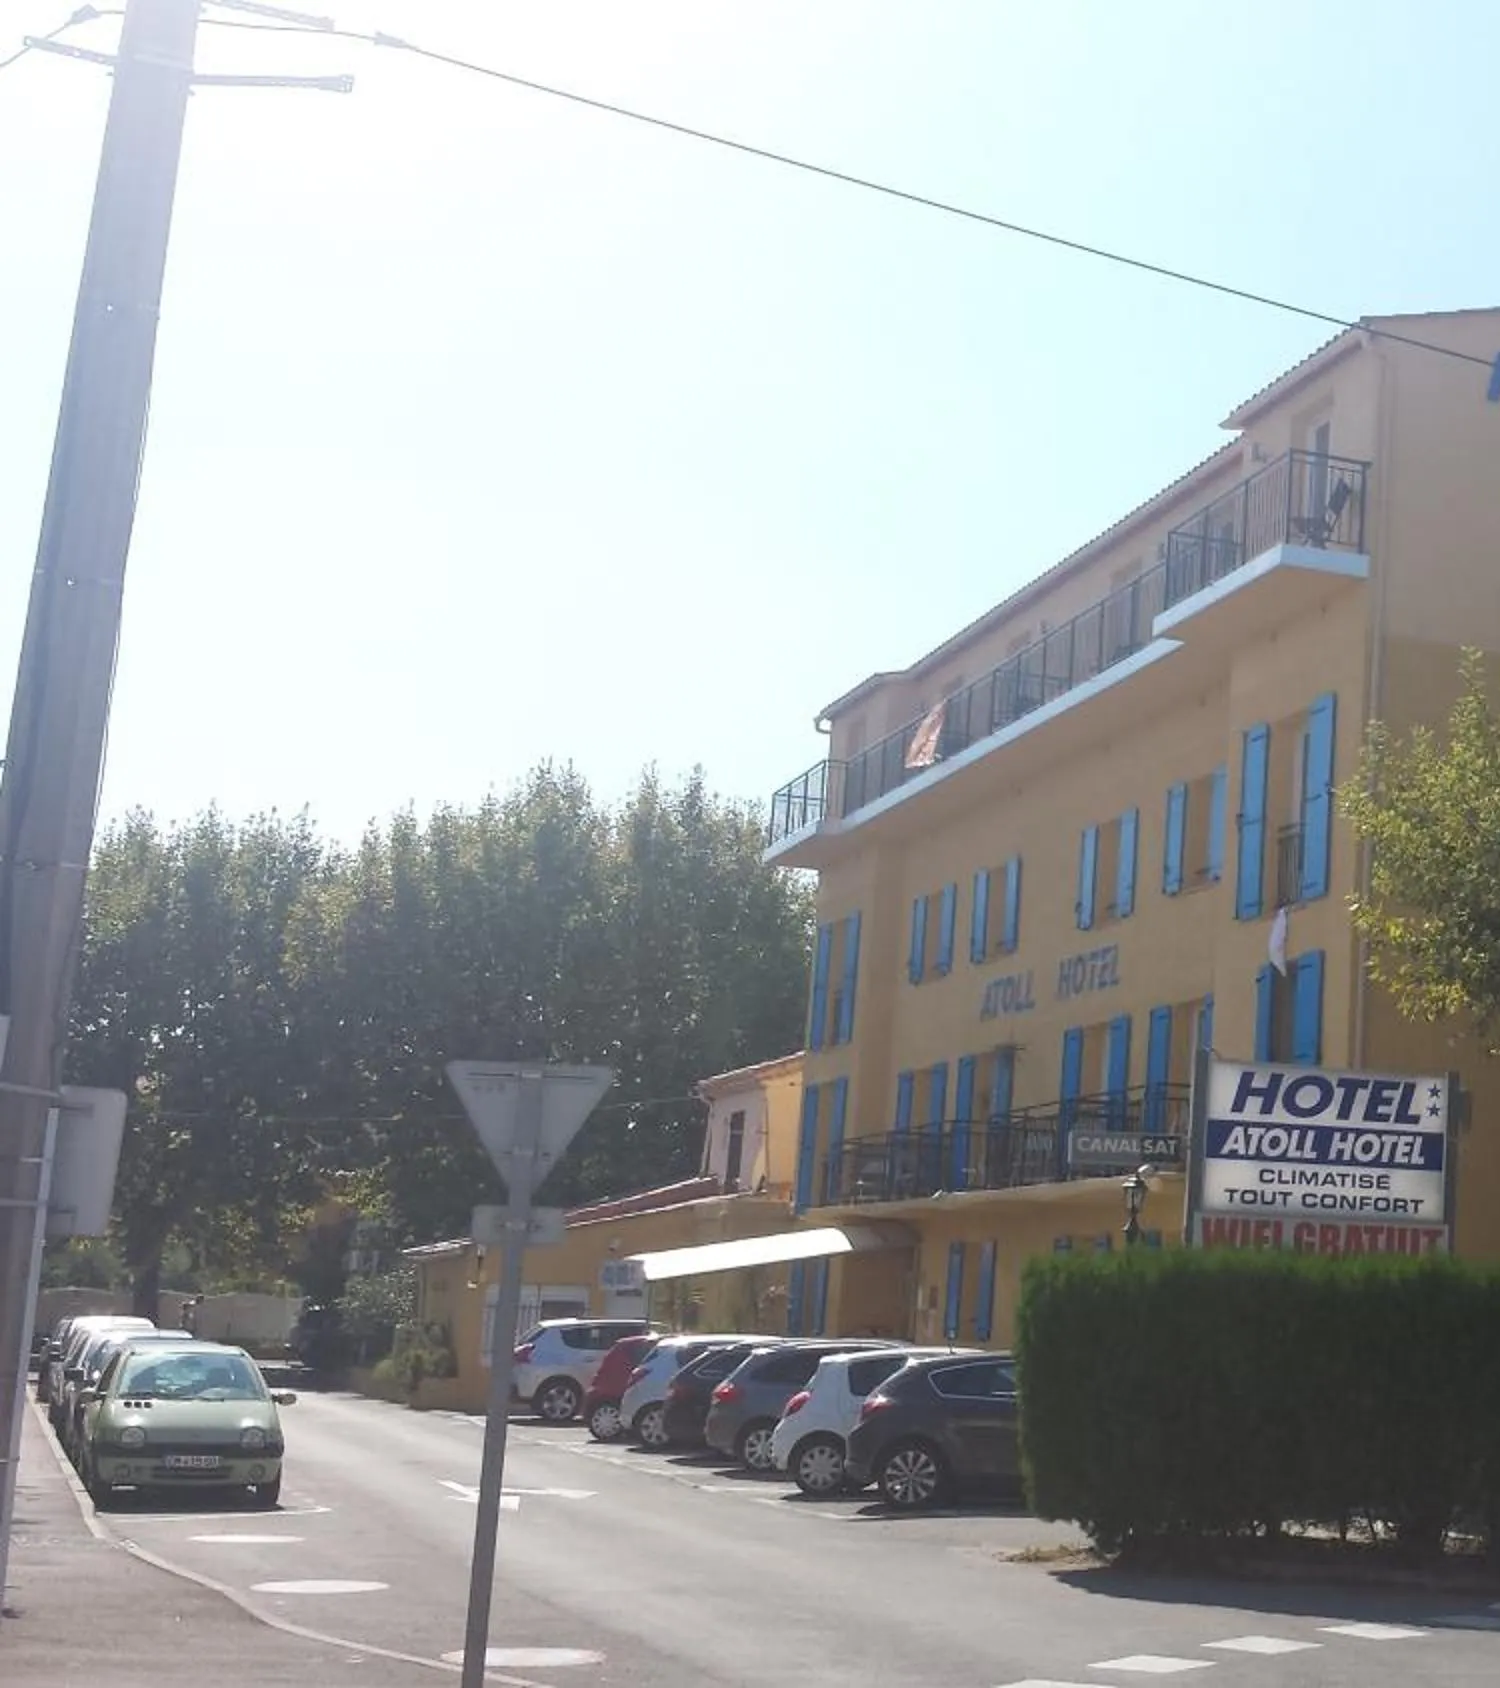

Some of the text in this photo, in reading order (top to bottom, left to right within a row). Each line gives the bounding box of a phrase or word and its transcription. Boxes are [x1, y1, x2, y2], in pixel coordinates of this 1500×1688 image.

[980, 942, 1120, 1022] ATOLL HOTEL
[1230, 1071, 1421, 1125] HOTEL
[1220, 1125, 1425, 1164] ATOLL HOTEL
[1259, 1168, 1391, 1190] CLIMATISE
[1224, 1188, 1424, 1214] TOUT CONFORT
